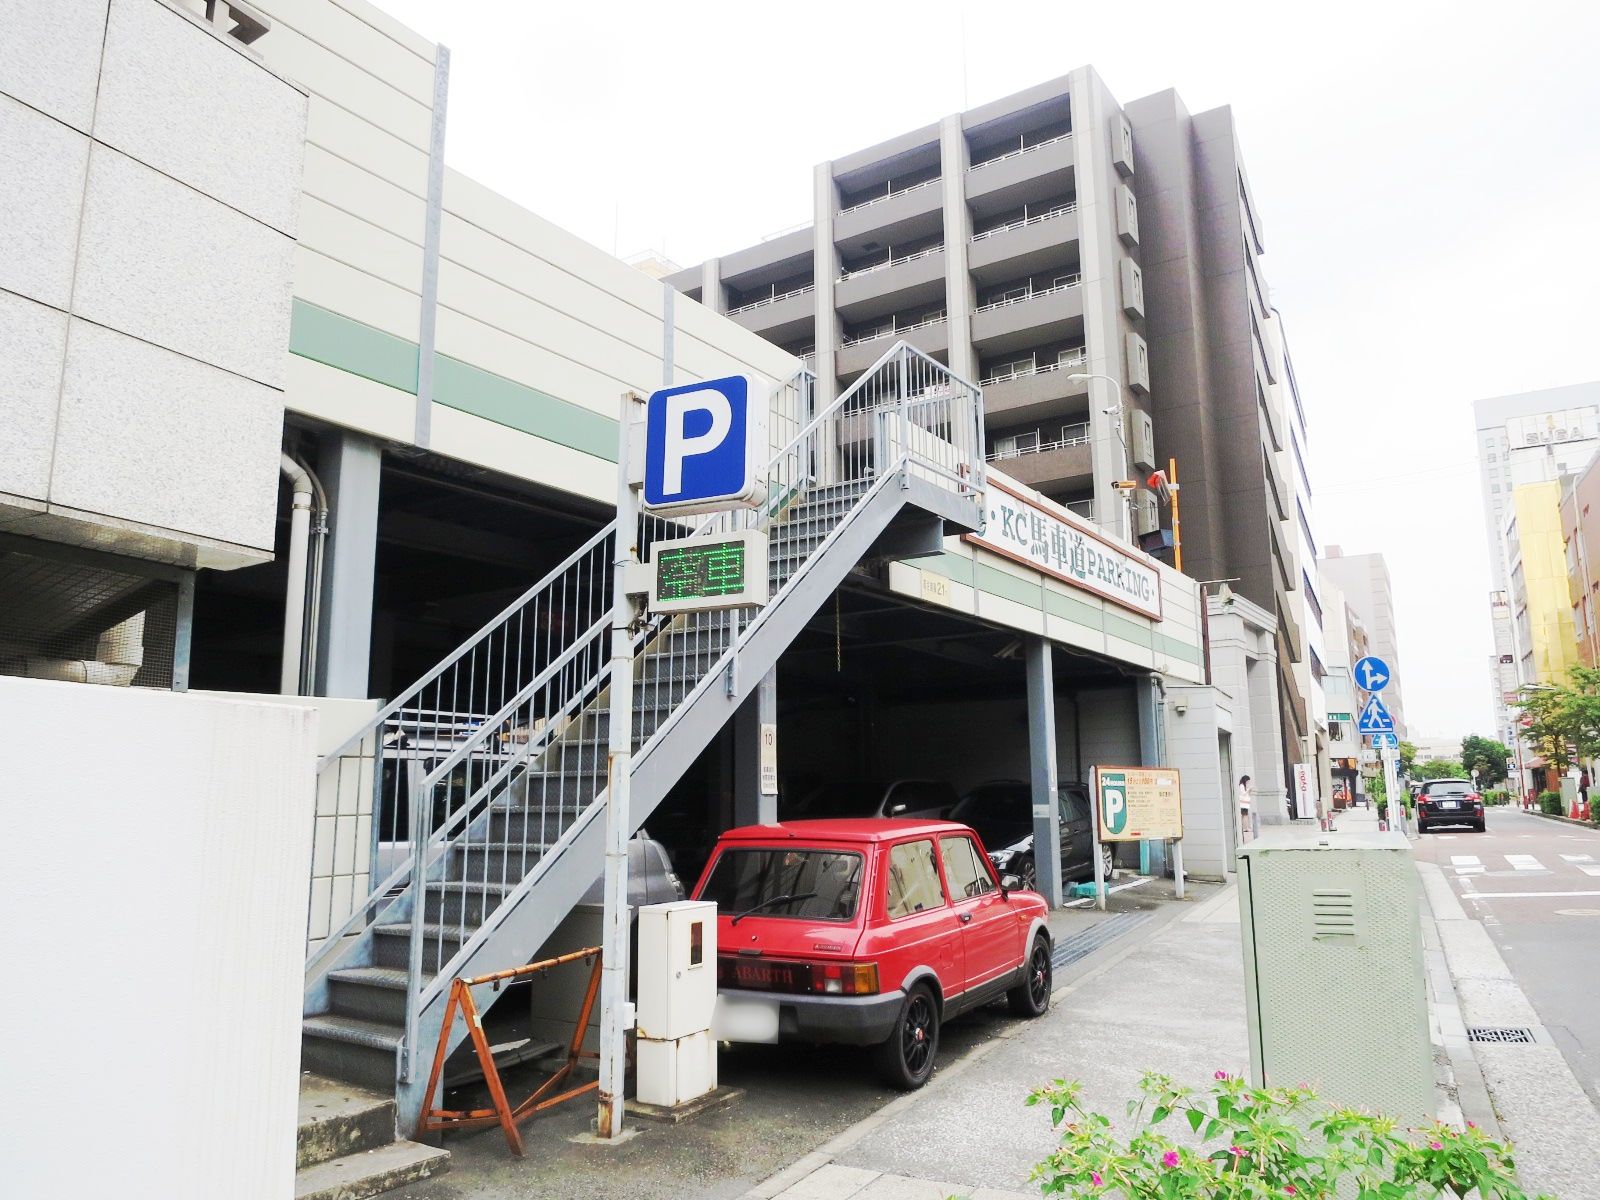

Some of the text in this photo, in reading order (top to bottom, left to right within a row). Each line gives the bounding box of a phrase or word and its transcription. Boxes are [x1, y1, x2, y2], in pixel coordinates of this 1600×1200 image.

[662, 388, 732, 495] P
[1105, 789, 1123, 828] P
[734, 965, 794, 984] ABARTH
